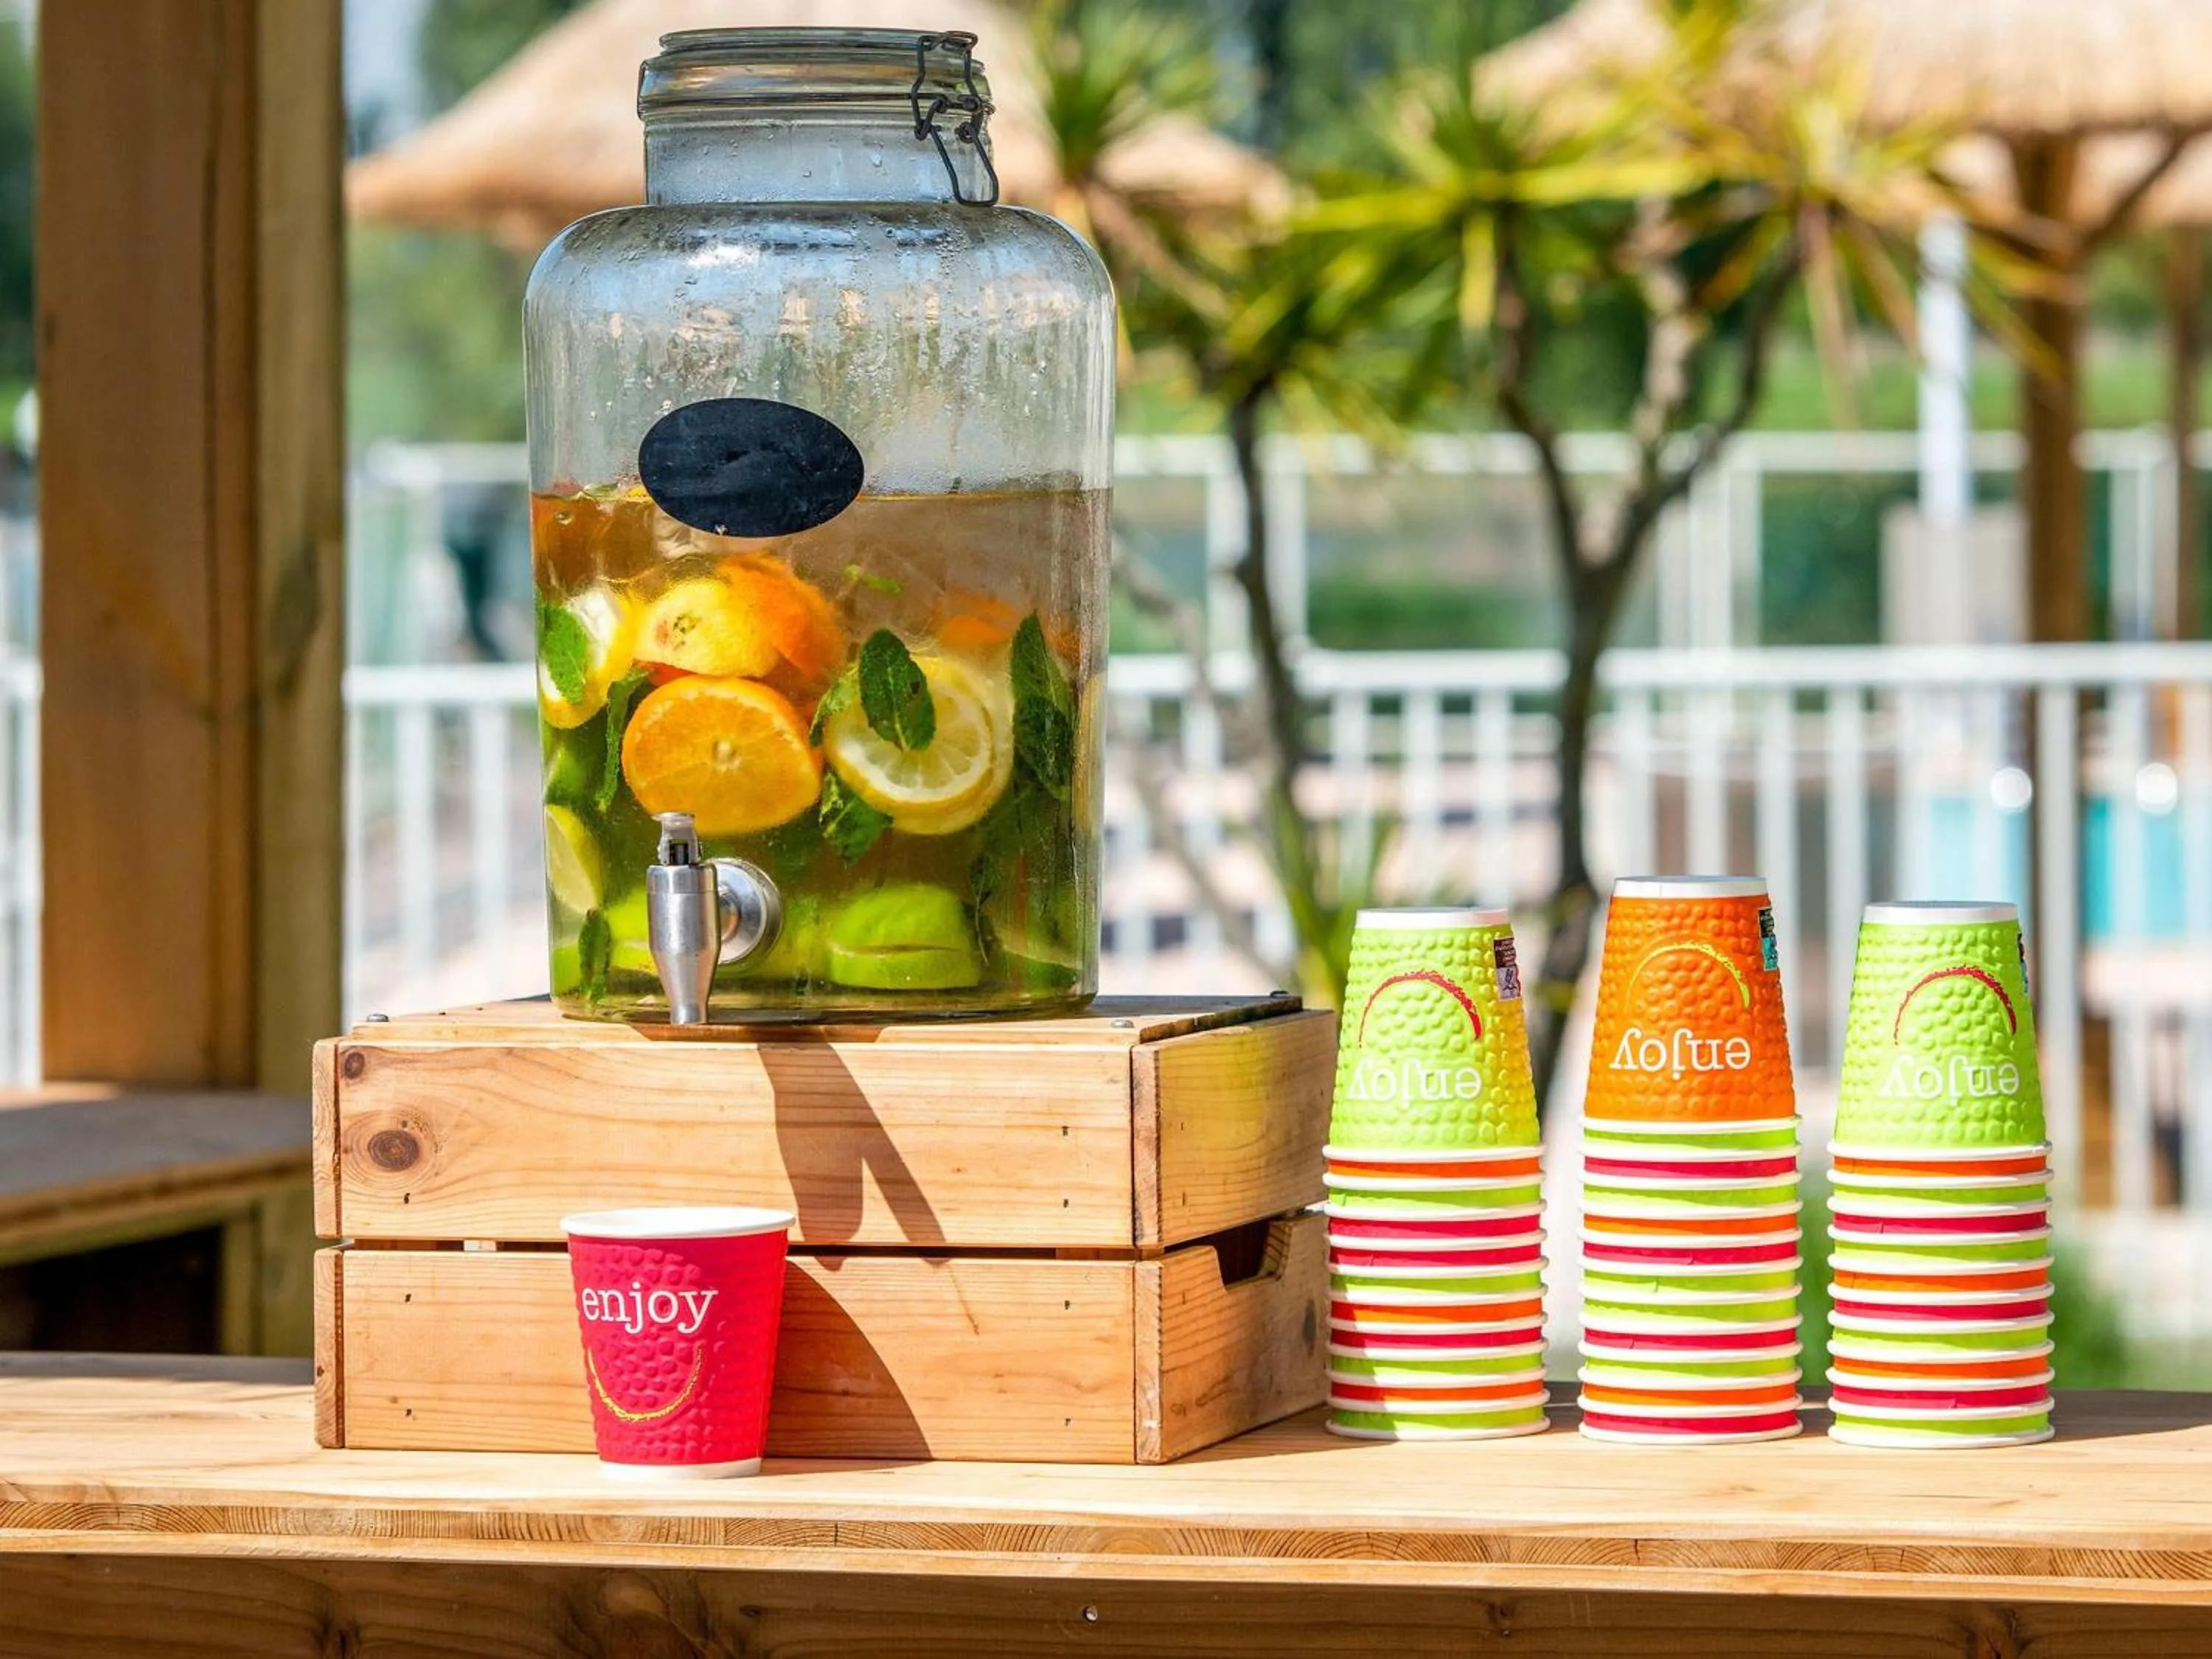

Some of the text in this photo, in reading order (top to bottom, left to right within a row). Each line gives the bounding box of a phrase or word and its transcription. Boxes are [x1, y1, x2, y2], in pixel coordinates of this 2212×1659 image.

[1610, 1027, 1751, 1080] enjoy
[1346, 1057, 1483, 1110] enjoy
[1877, 1055, 2020, 1107] enjoy
[581, 1281, 719, 1334] enjoy
